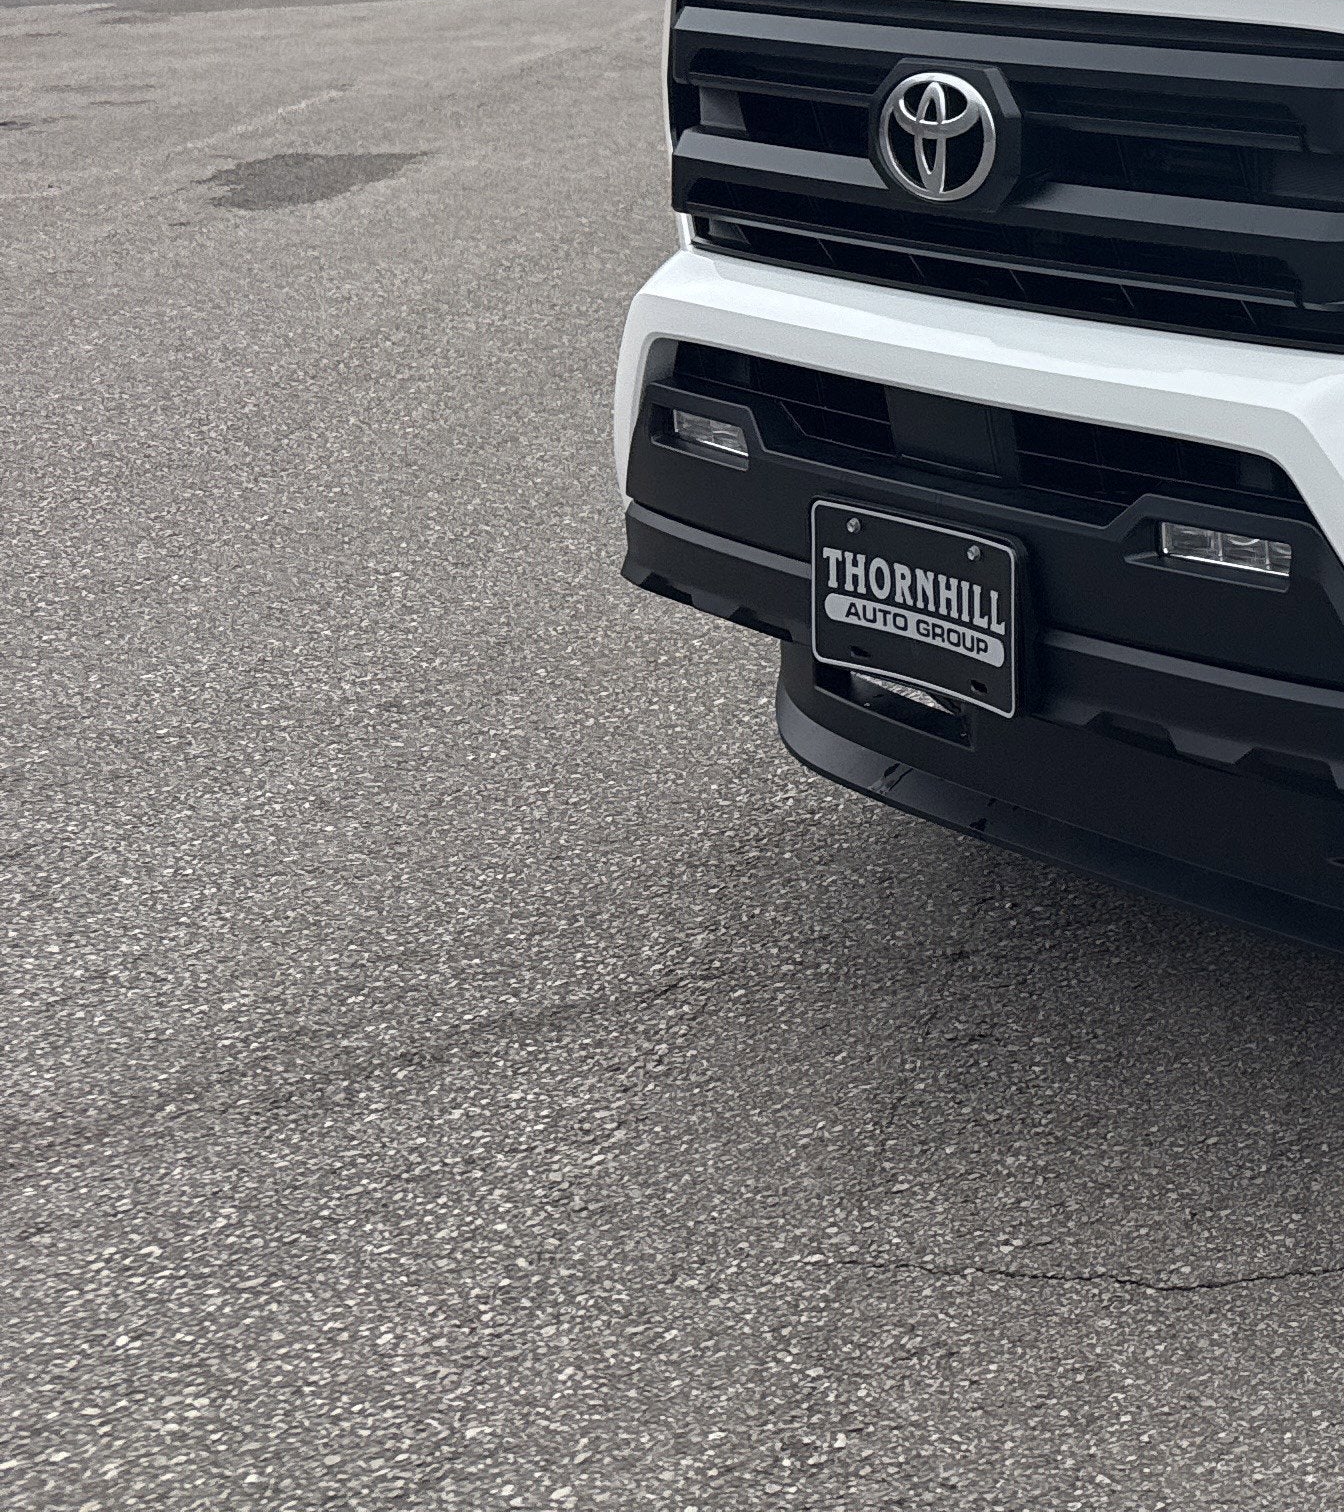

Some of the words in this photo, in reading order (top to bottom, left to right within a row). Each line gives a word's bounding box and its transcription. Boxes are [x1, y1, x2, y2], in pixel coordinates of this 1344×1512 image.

[822, 546, 1006, 636] THORNHILL
[845, 602, 908, 632] AUTO
[915, 618, 989, 655] GROUP
